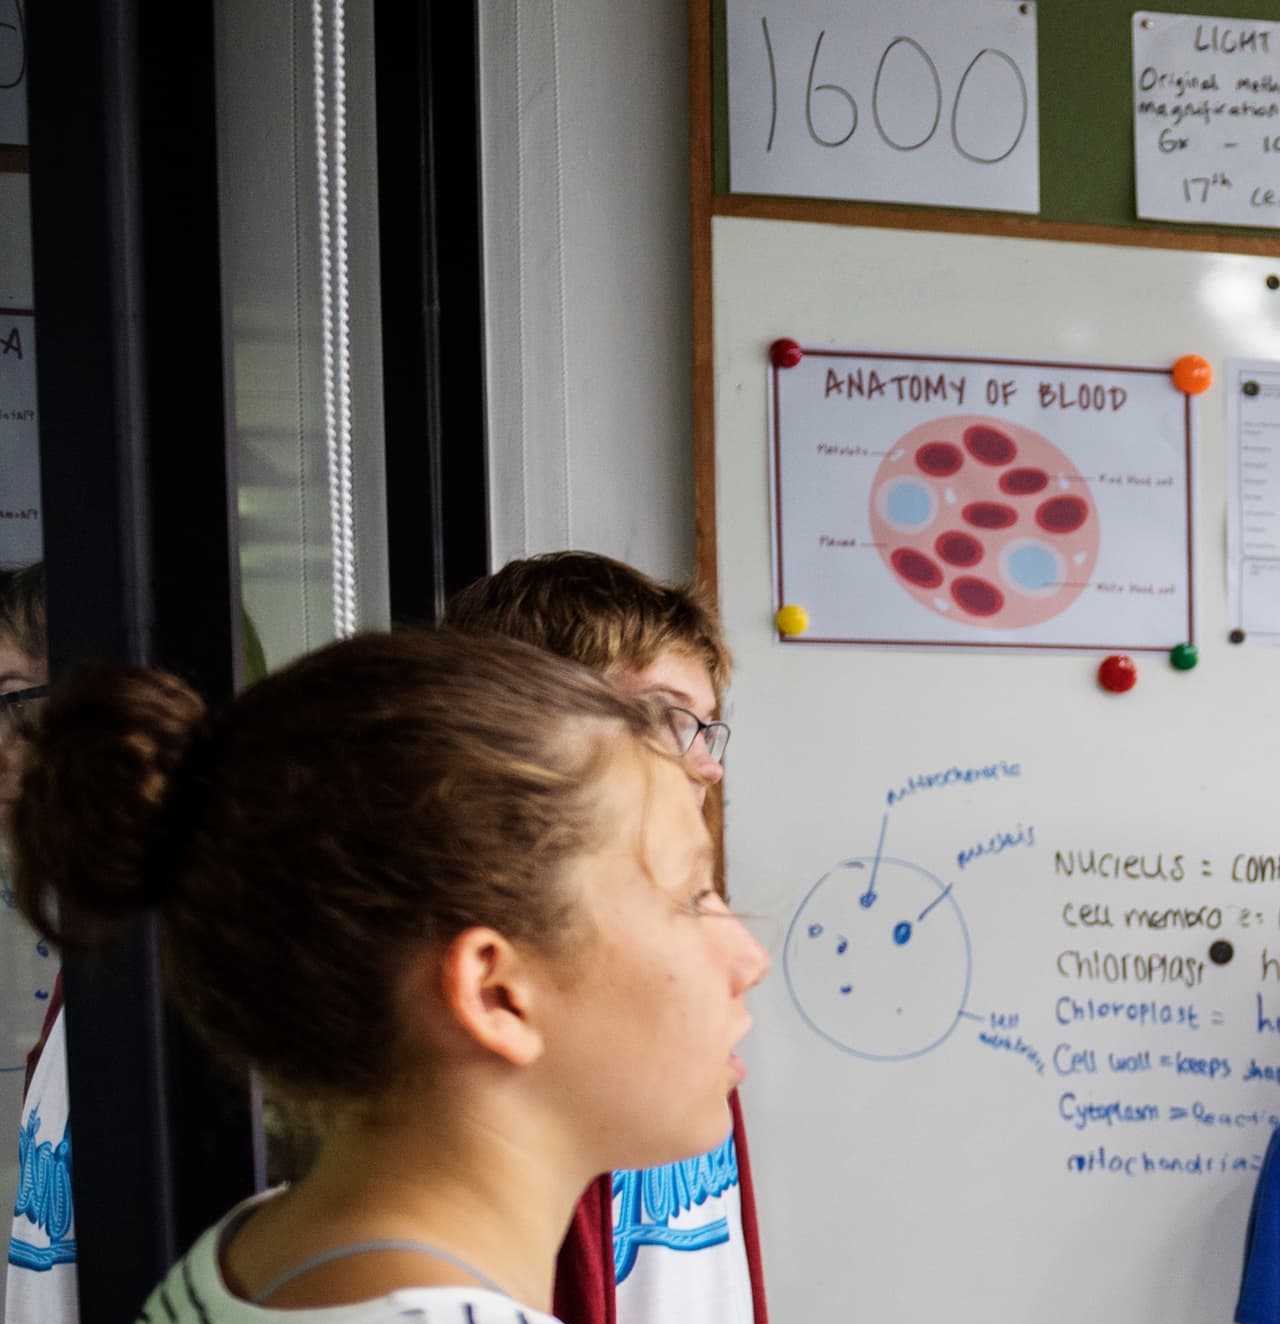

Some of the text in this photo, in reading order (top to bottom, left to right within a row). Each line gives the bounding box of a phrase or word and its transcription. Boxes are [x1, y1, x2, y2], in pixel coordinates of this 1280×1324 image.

[1193, 23, 1273, 54] LIGHT
[760, 15, 1029, 165] 1600
[1138, 66, 1219, 97] Original
[1138, 99, 1280, 126] magnification
[823, 366, 1130, 412] ANATOMY OF BLOOD
[1055, 995, 1201, 1032] Chloroplast
[1050, 1042, 1098, 1078] Cell
